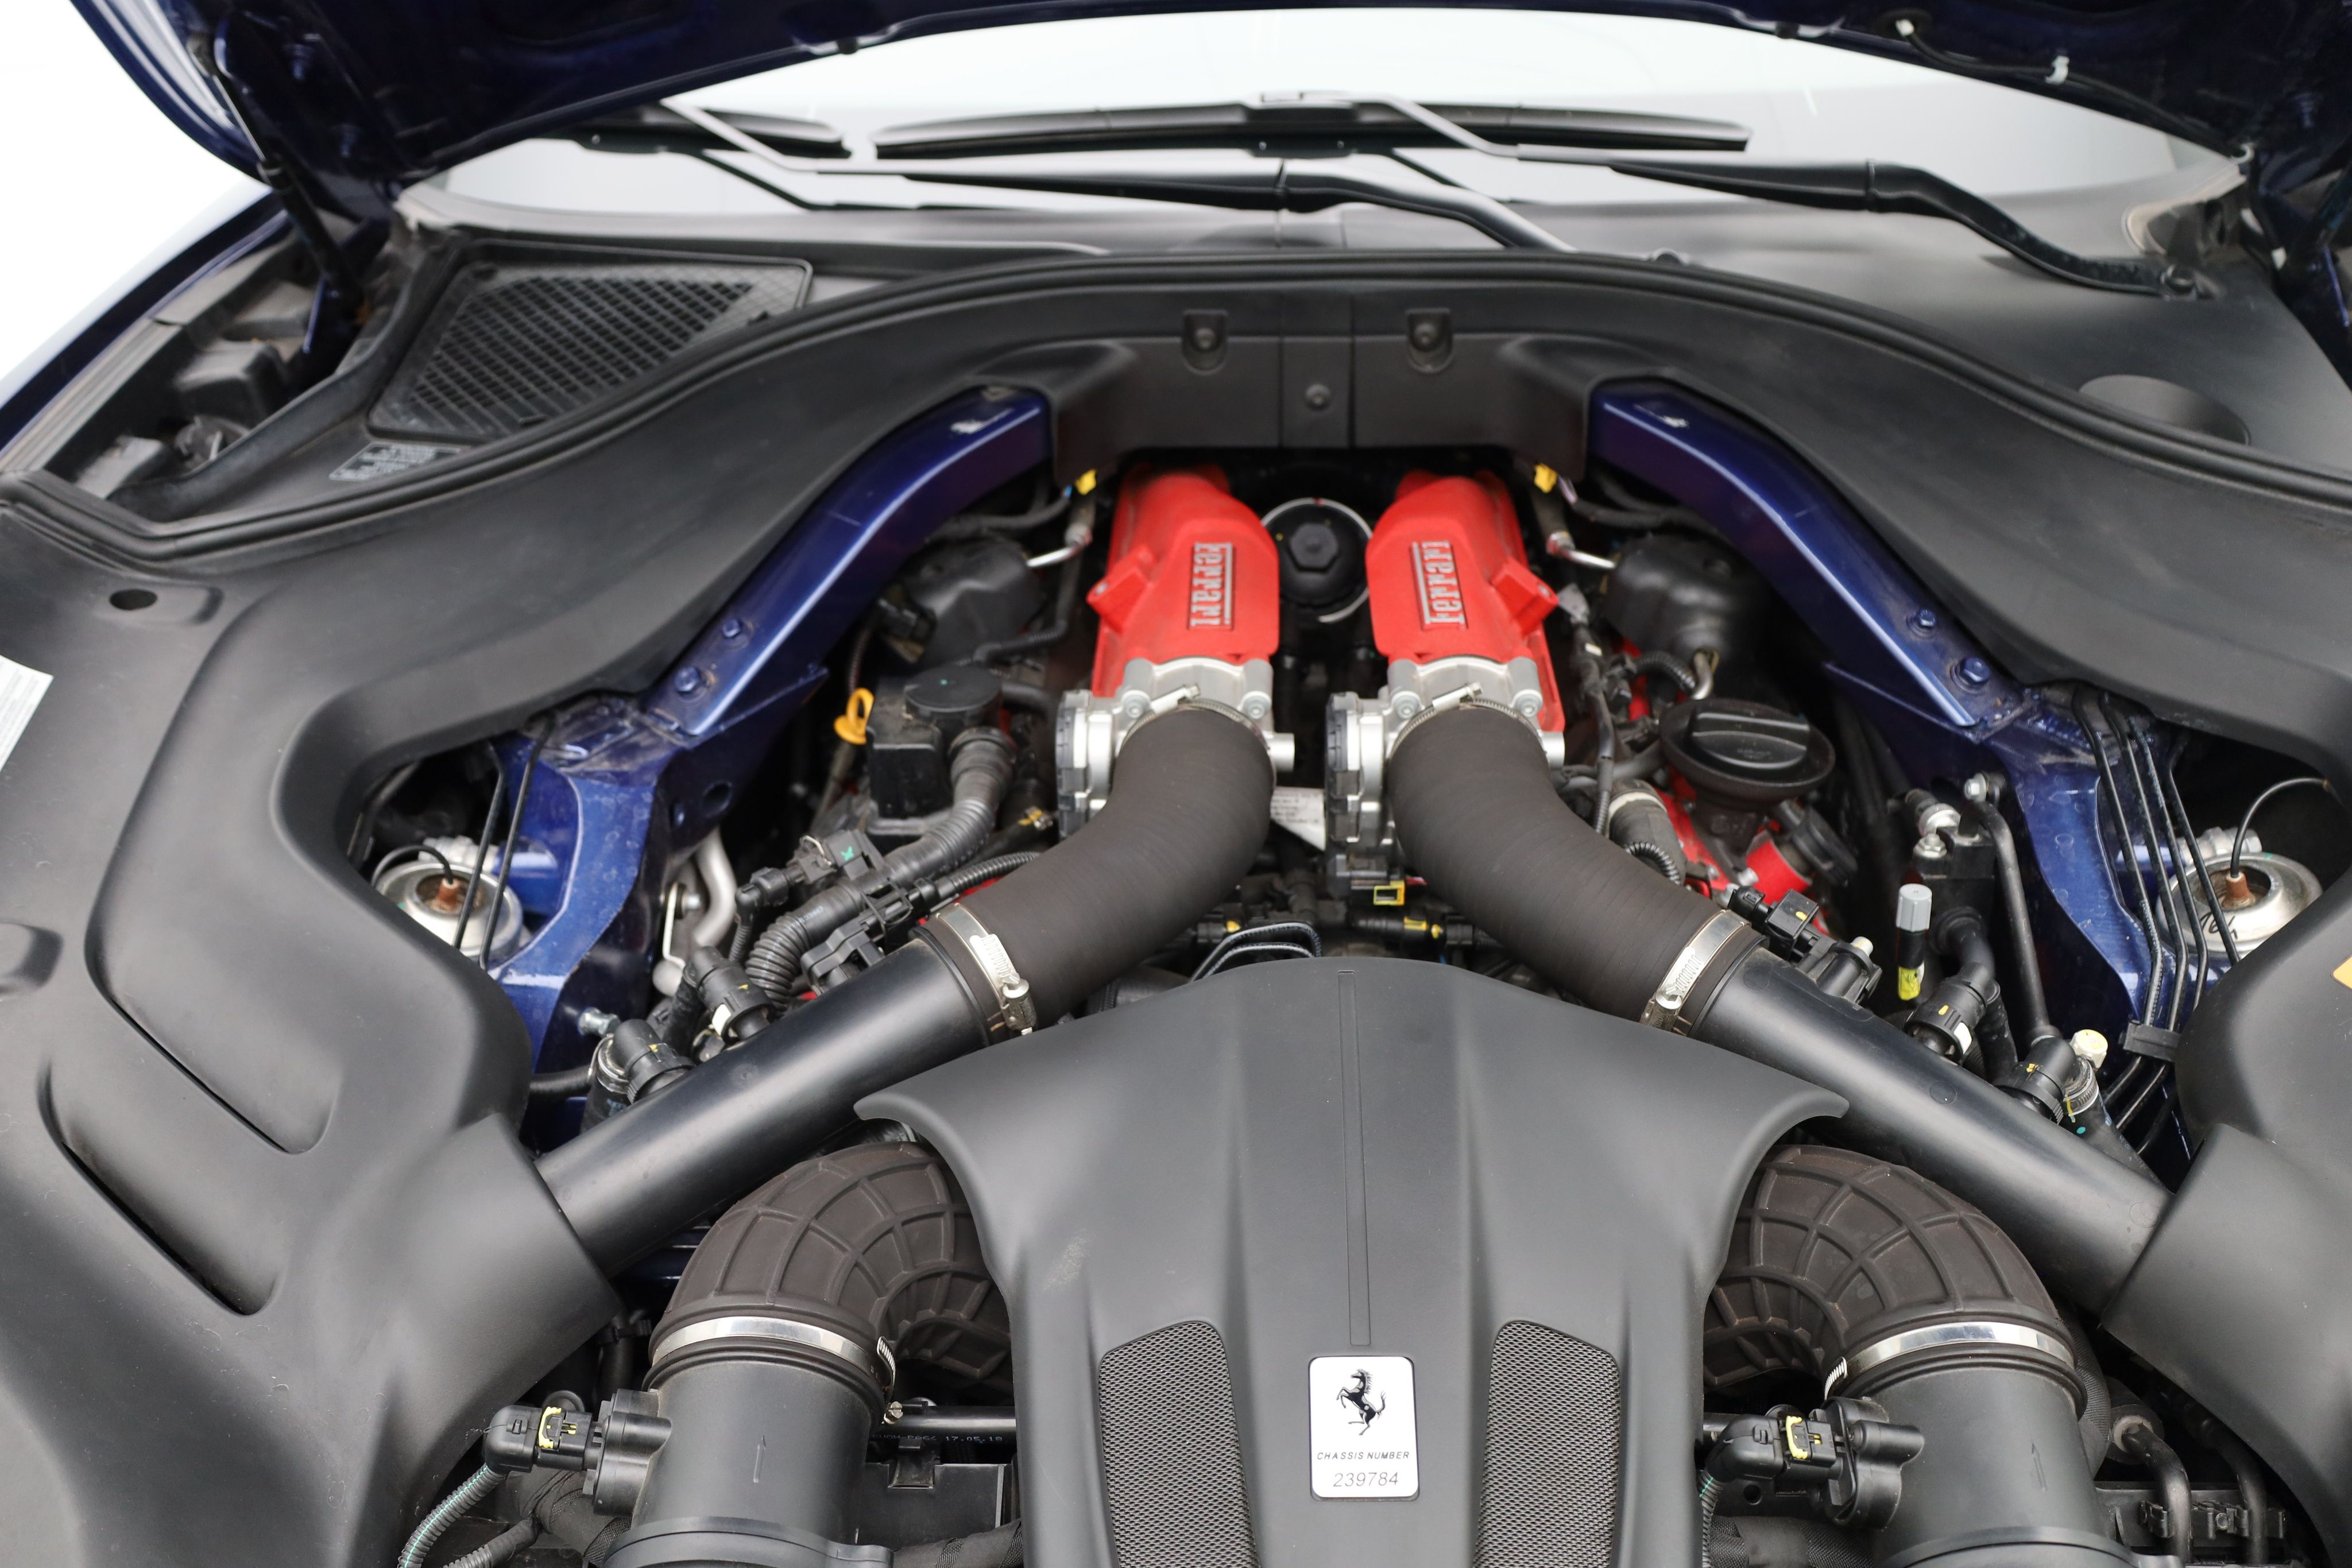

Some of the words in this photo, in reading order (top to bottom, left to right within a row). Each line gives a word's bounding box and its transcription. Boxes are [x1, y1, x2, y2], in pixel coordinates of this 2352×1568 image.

[1190, 542, 1233, 627] Ferrari
[1413, 541, 1465, 625] Ferrari
[1317, 1451, 1364, 1460] CHASSIS
[1367, 1451, 1410, 1459] NUMBER
[1333, 1472, 1398, 1487] 239784
